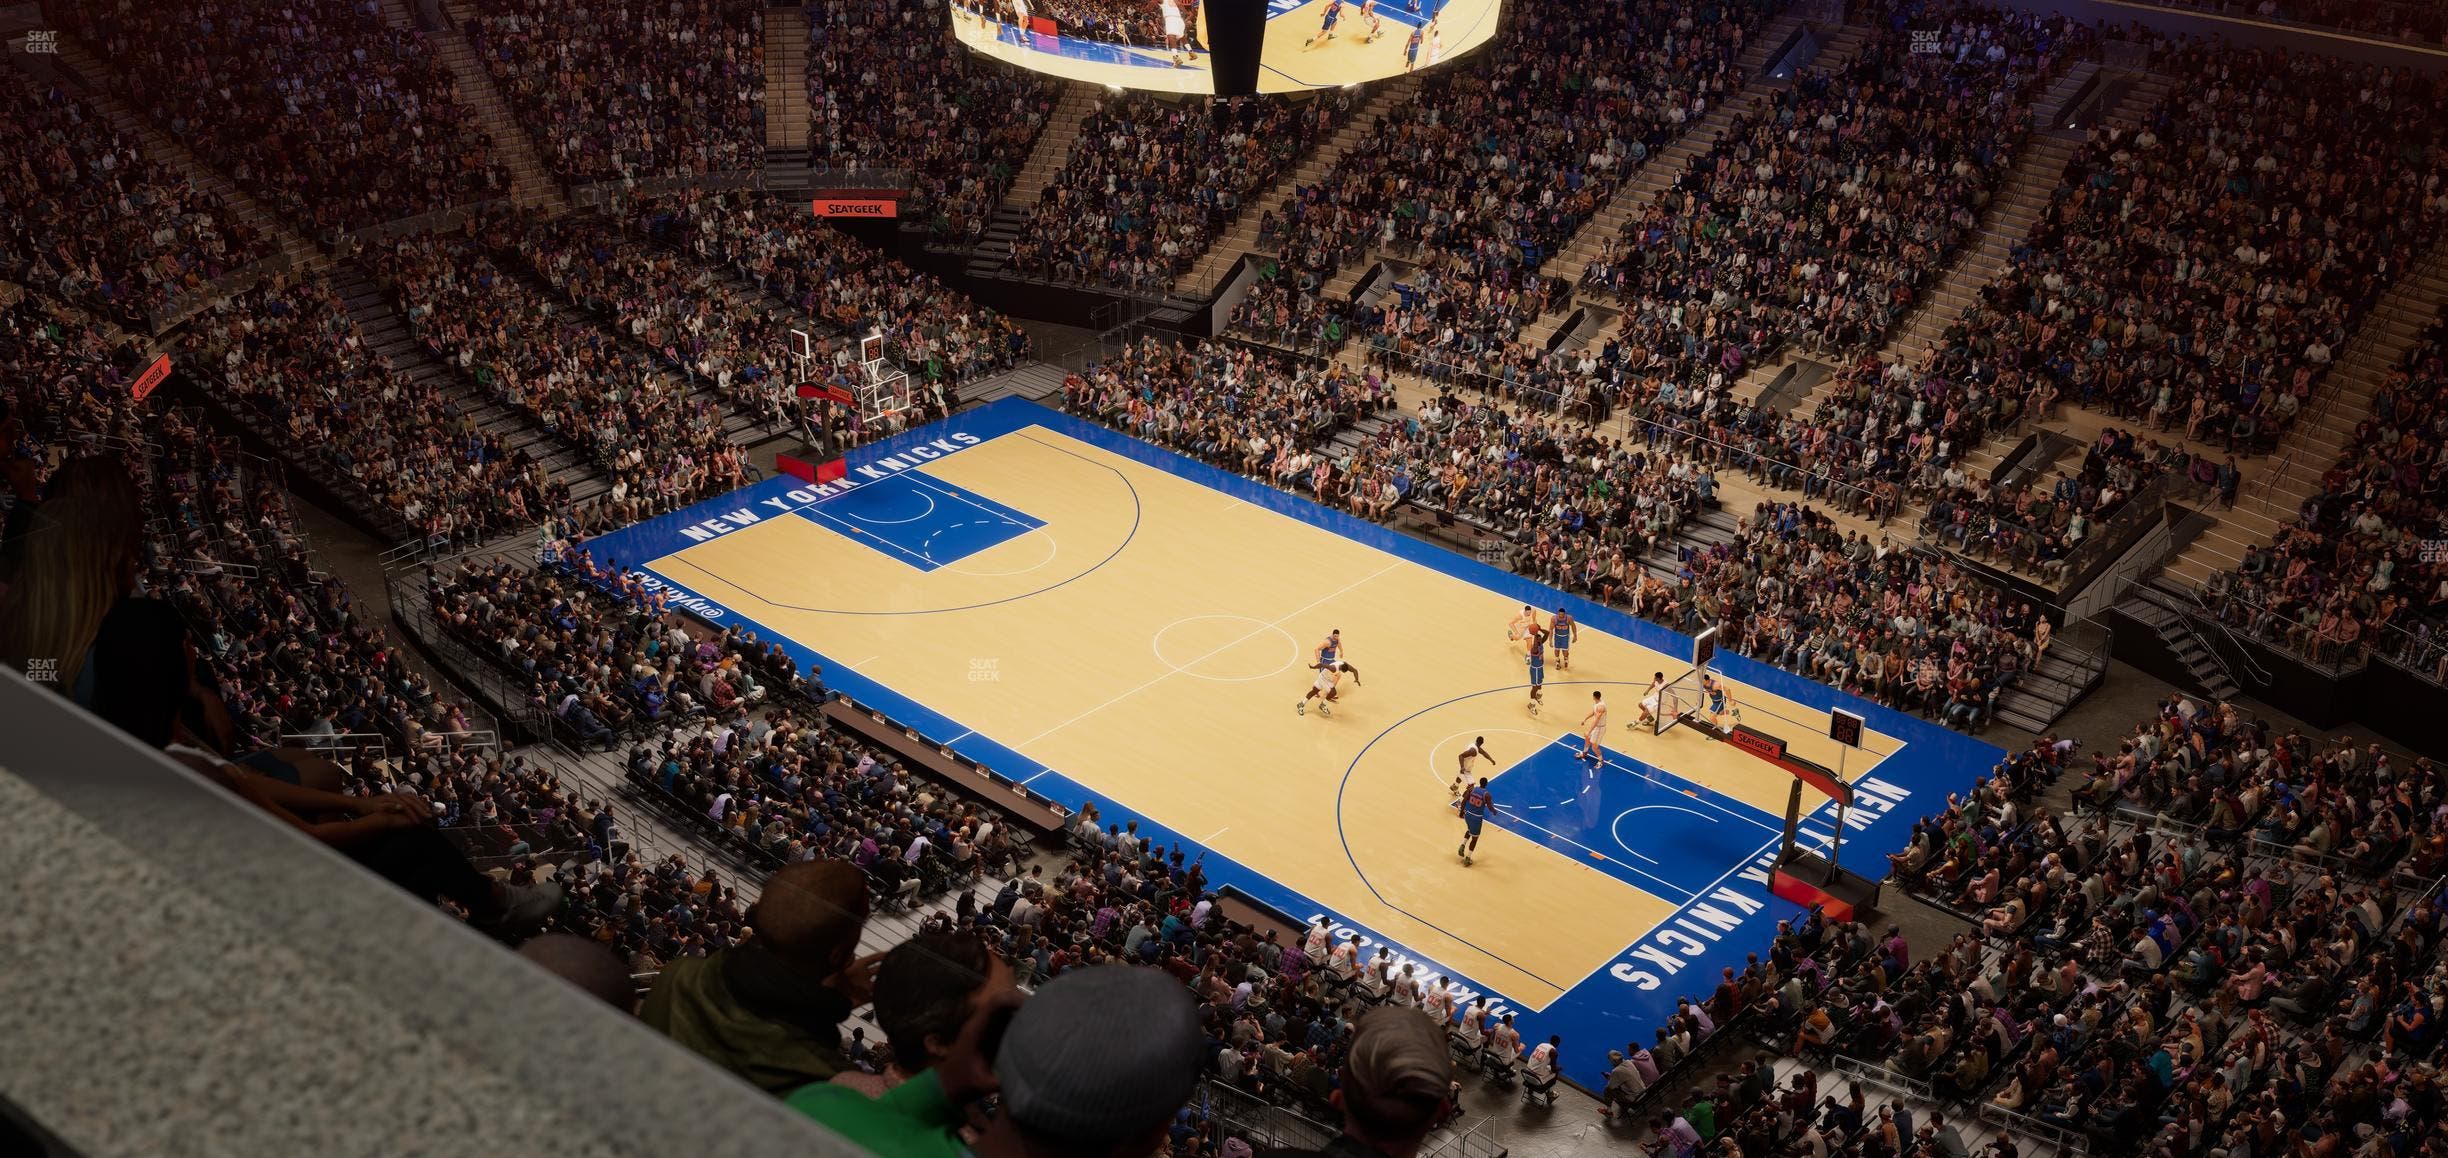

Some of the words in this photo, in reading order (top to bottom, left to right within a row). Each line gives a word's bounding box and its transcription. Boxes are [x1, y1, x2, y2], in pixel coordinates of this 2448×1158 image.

[828, 204, 883, 215] SEATGEEK
[680, 508, 762, 542] NEW
[760, 477, 860, 511] YORK
[855, 432, 981, 479] KNICKS
[1738, 734, 1774, 753] SEATGEEK
[1824, 777, 1912, 831] NEW
[1610, 886, 1765, 990] KNICKS
